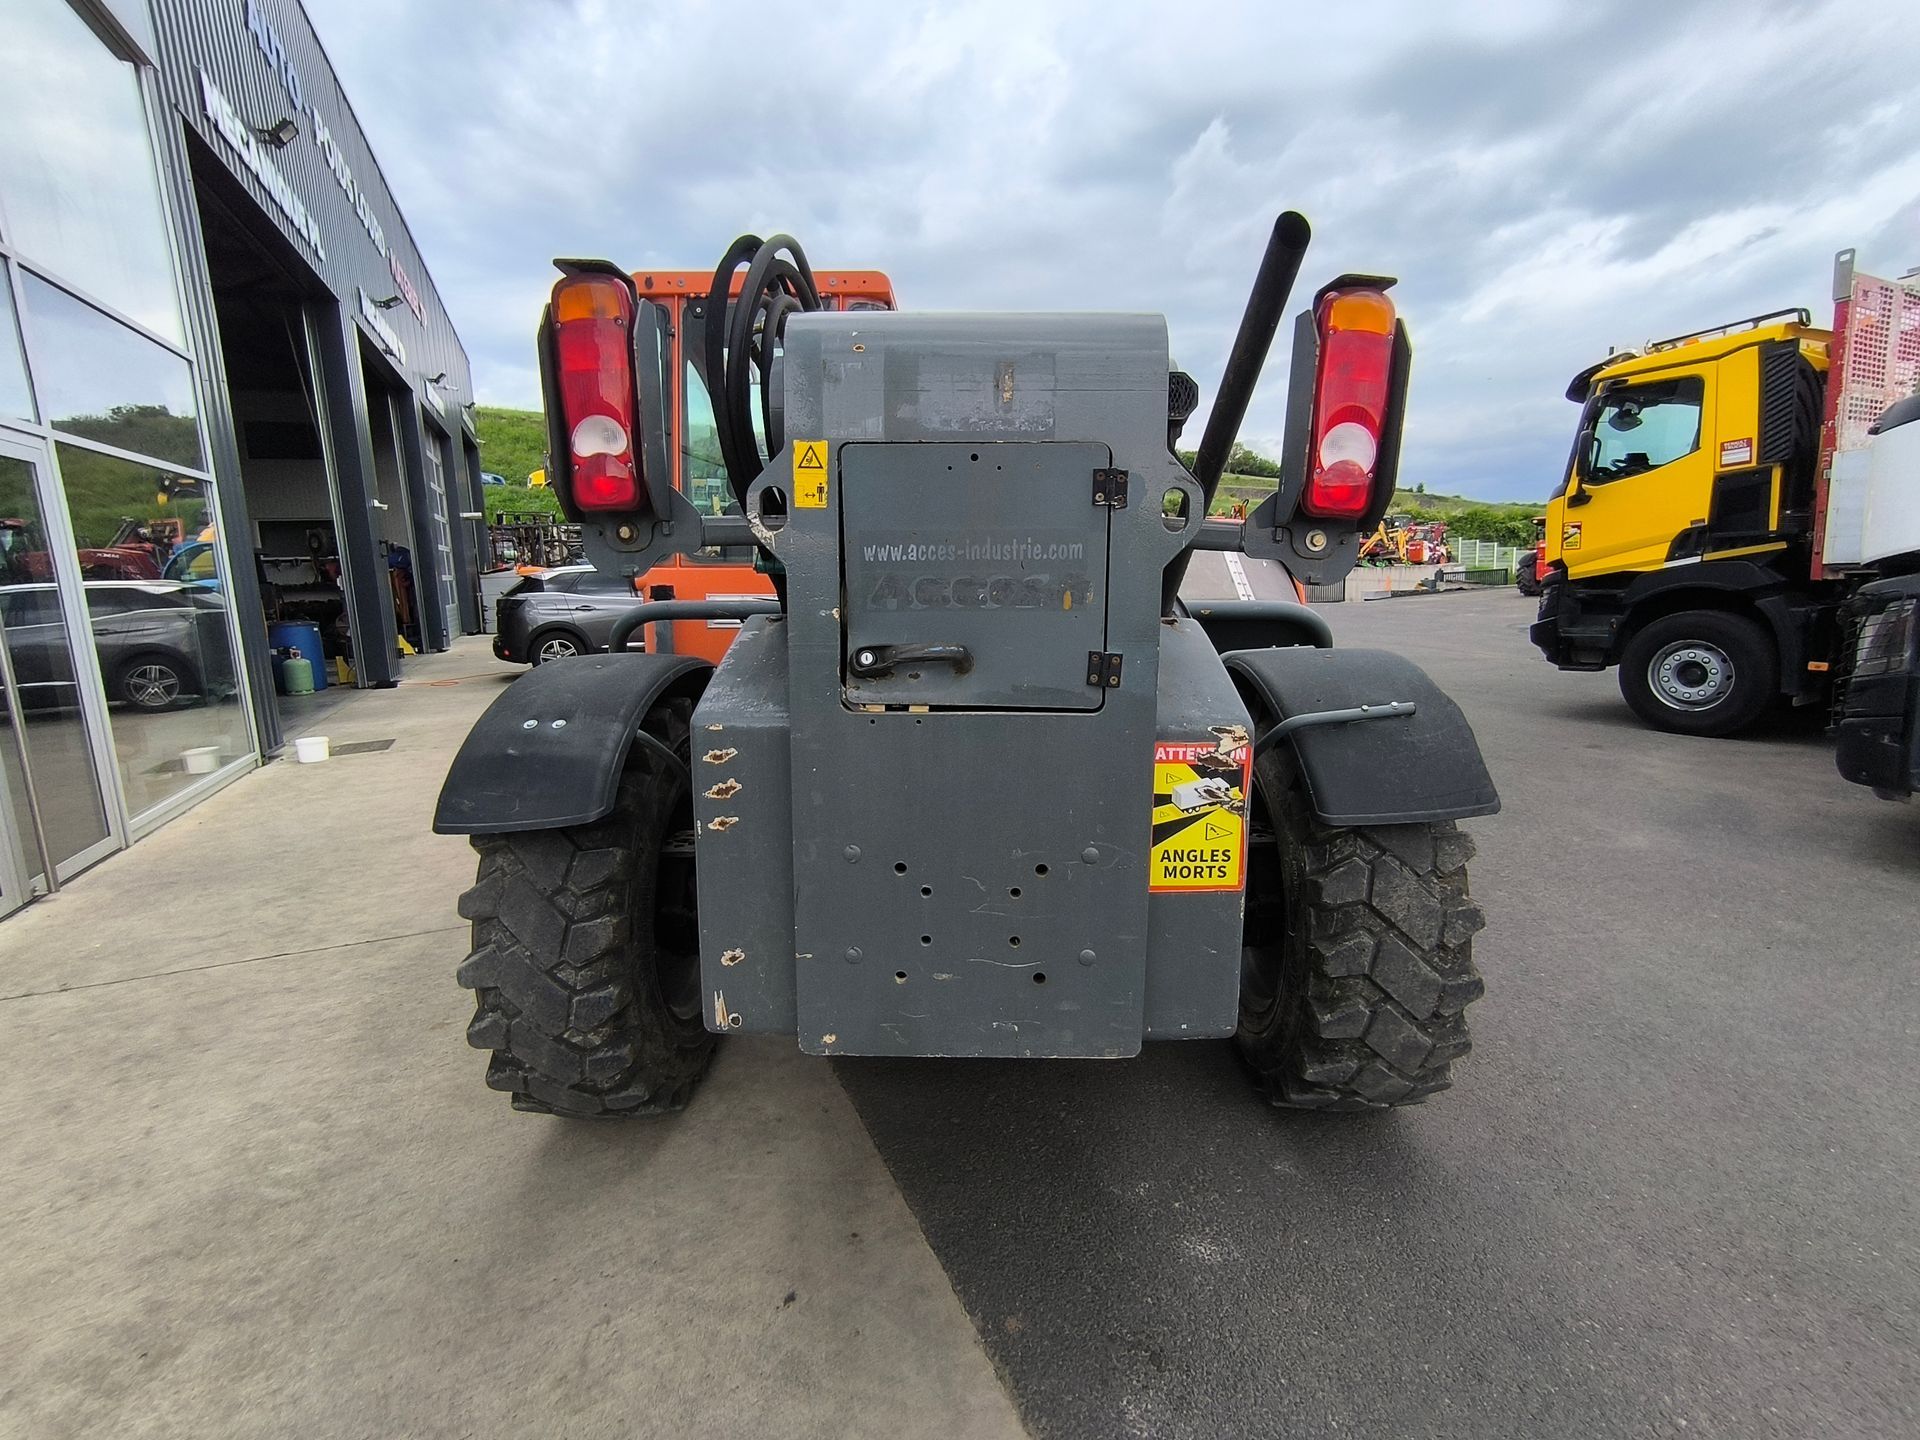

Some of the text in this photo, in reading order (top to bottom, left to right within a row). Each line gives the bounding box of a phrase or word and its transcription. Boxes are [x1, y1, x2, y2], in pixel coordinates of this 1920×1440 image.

[313, 108, 354, 204] POIDS
[863, 537, 1083, 562] www.acces-industrie.com
[1160, 849, 1231, 863] ANGLES
[1163, 865, 1227, 879] MORTS
